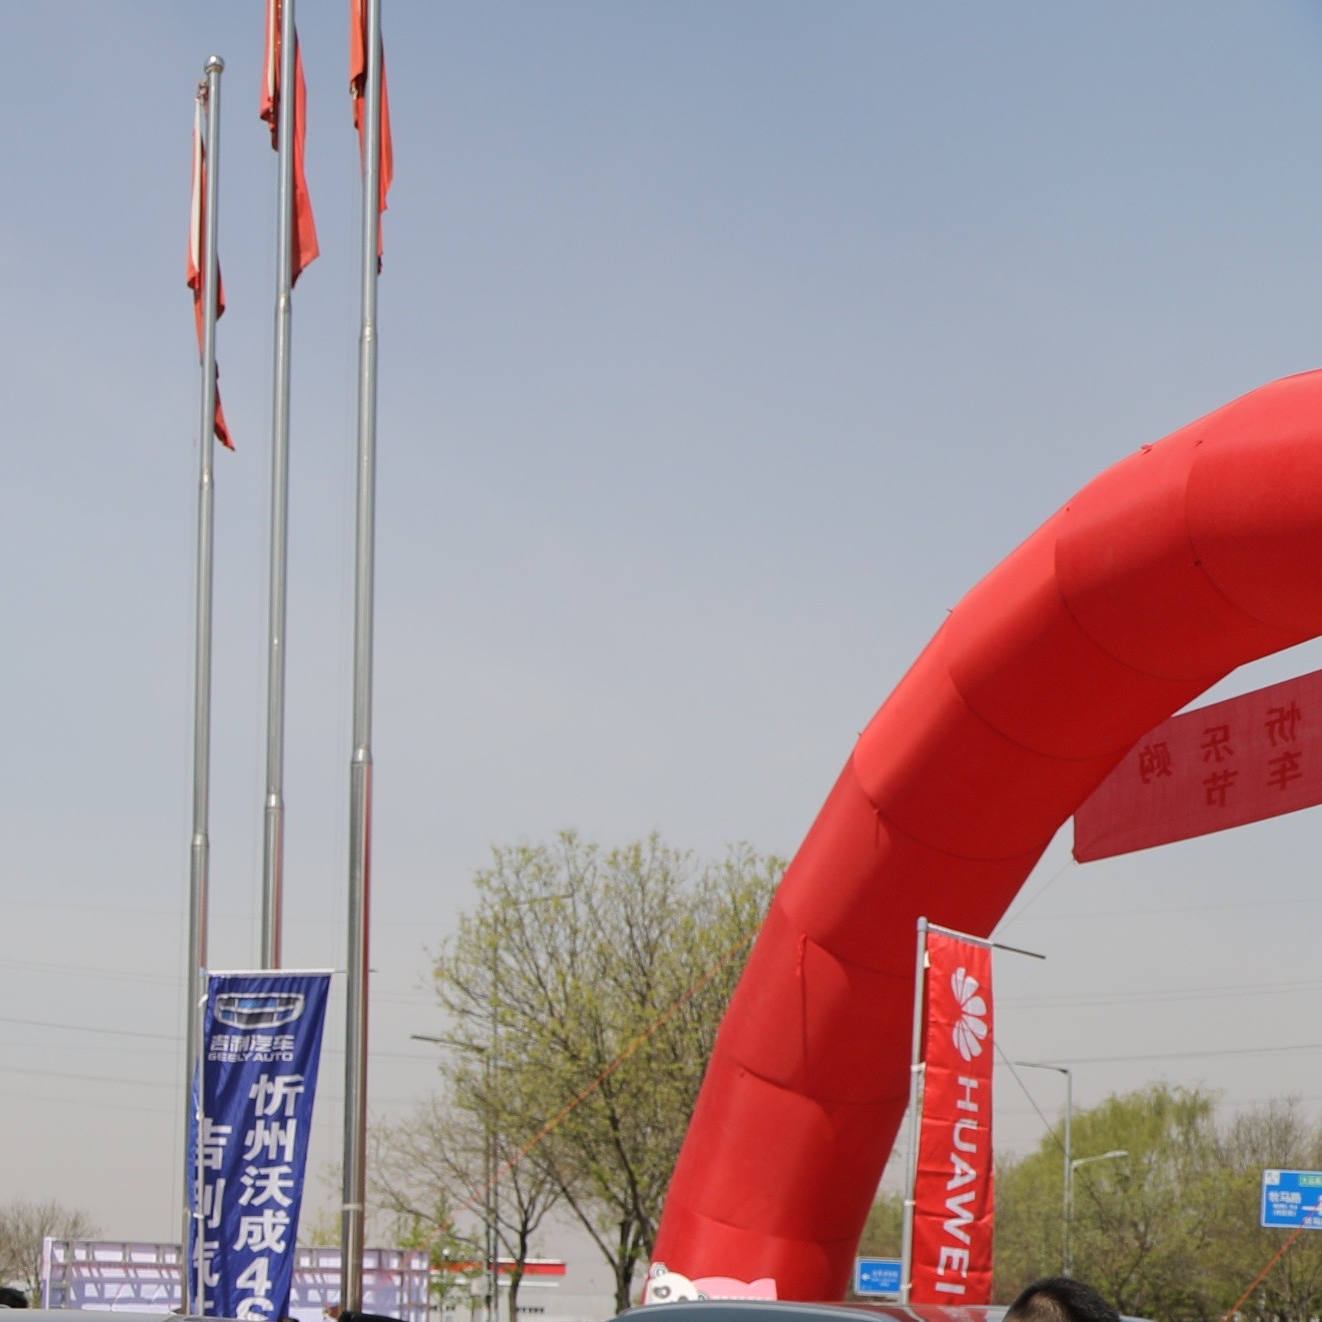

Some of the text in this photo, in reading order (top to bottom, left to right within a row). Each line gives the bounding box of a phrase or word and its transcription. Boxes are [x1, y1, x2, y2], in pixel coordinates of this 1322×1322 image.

[210, 1033, 295, 1052] 吉利汽车
[208, 1051, 294, 1063] GEELY AUTO
[935, 1075, 980, 1296] HUAWEI
